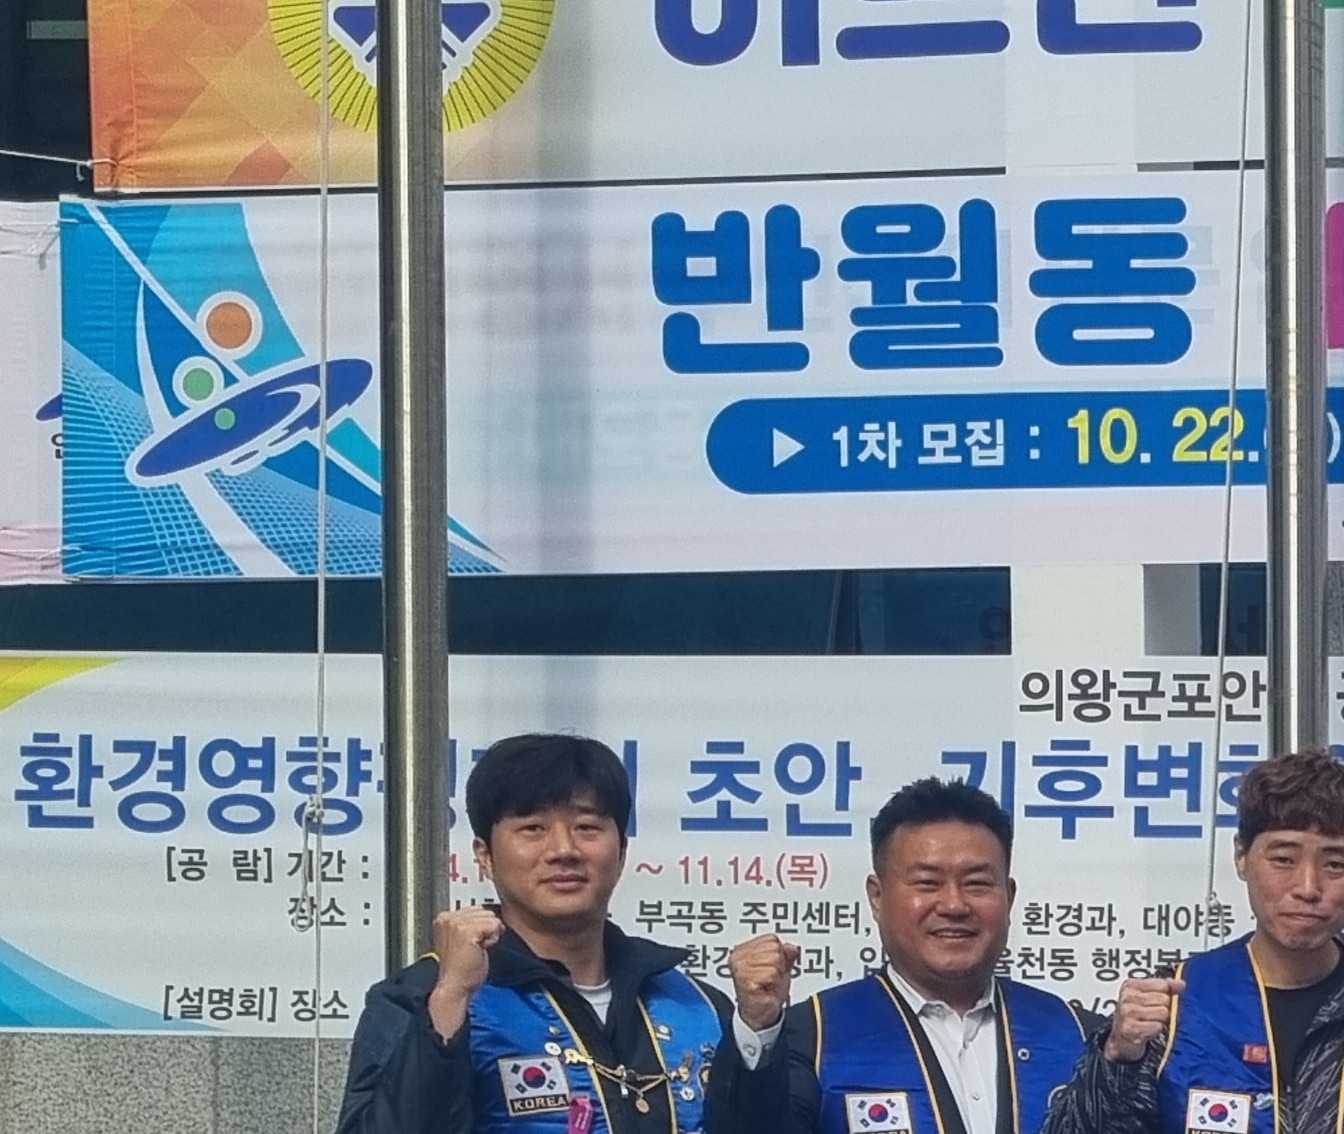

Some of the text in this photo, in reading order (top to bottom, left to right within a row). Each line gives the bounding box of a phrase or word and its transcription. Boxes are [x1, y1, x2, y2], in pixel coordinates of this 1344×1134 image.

[651, 197, 1196, 374] 반월동
[832, 421, 902, 470] 1차
[918, 417, 1004, 466] 모집
[1068, 409, 1151, 465] 10.
[288, 847, 348, 882] 기간
[679, 853, 829, 890] 11.14.(목)
[288, 896, 348, 933] 장소
[635, 900, 873, 937] 부곡동 주민센터,
[1021, 901, 1127, 939] 환경과,
[163, 986, 350, 1022] [설명회] 장소
[512, 1094, 568, 1111] KOREA
